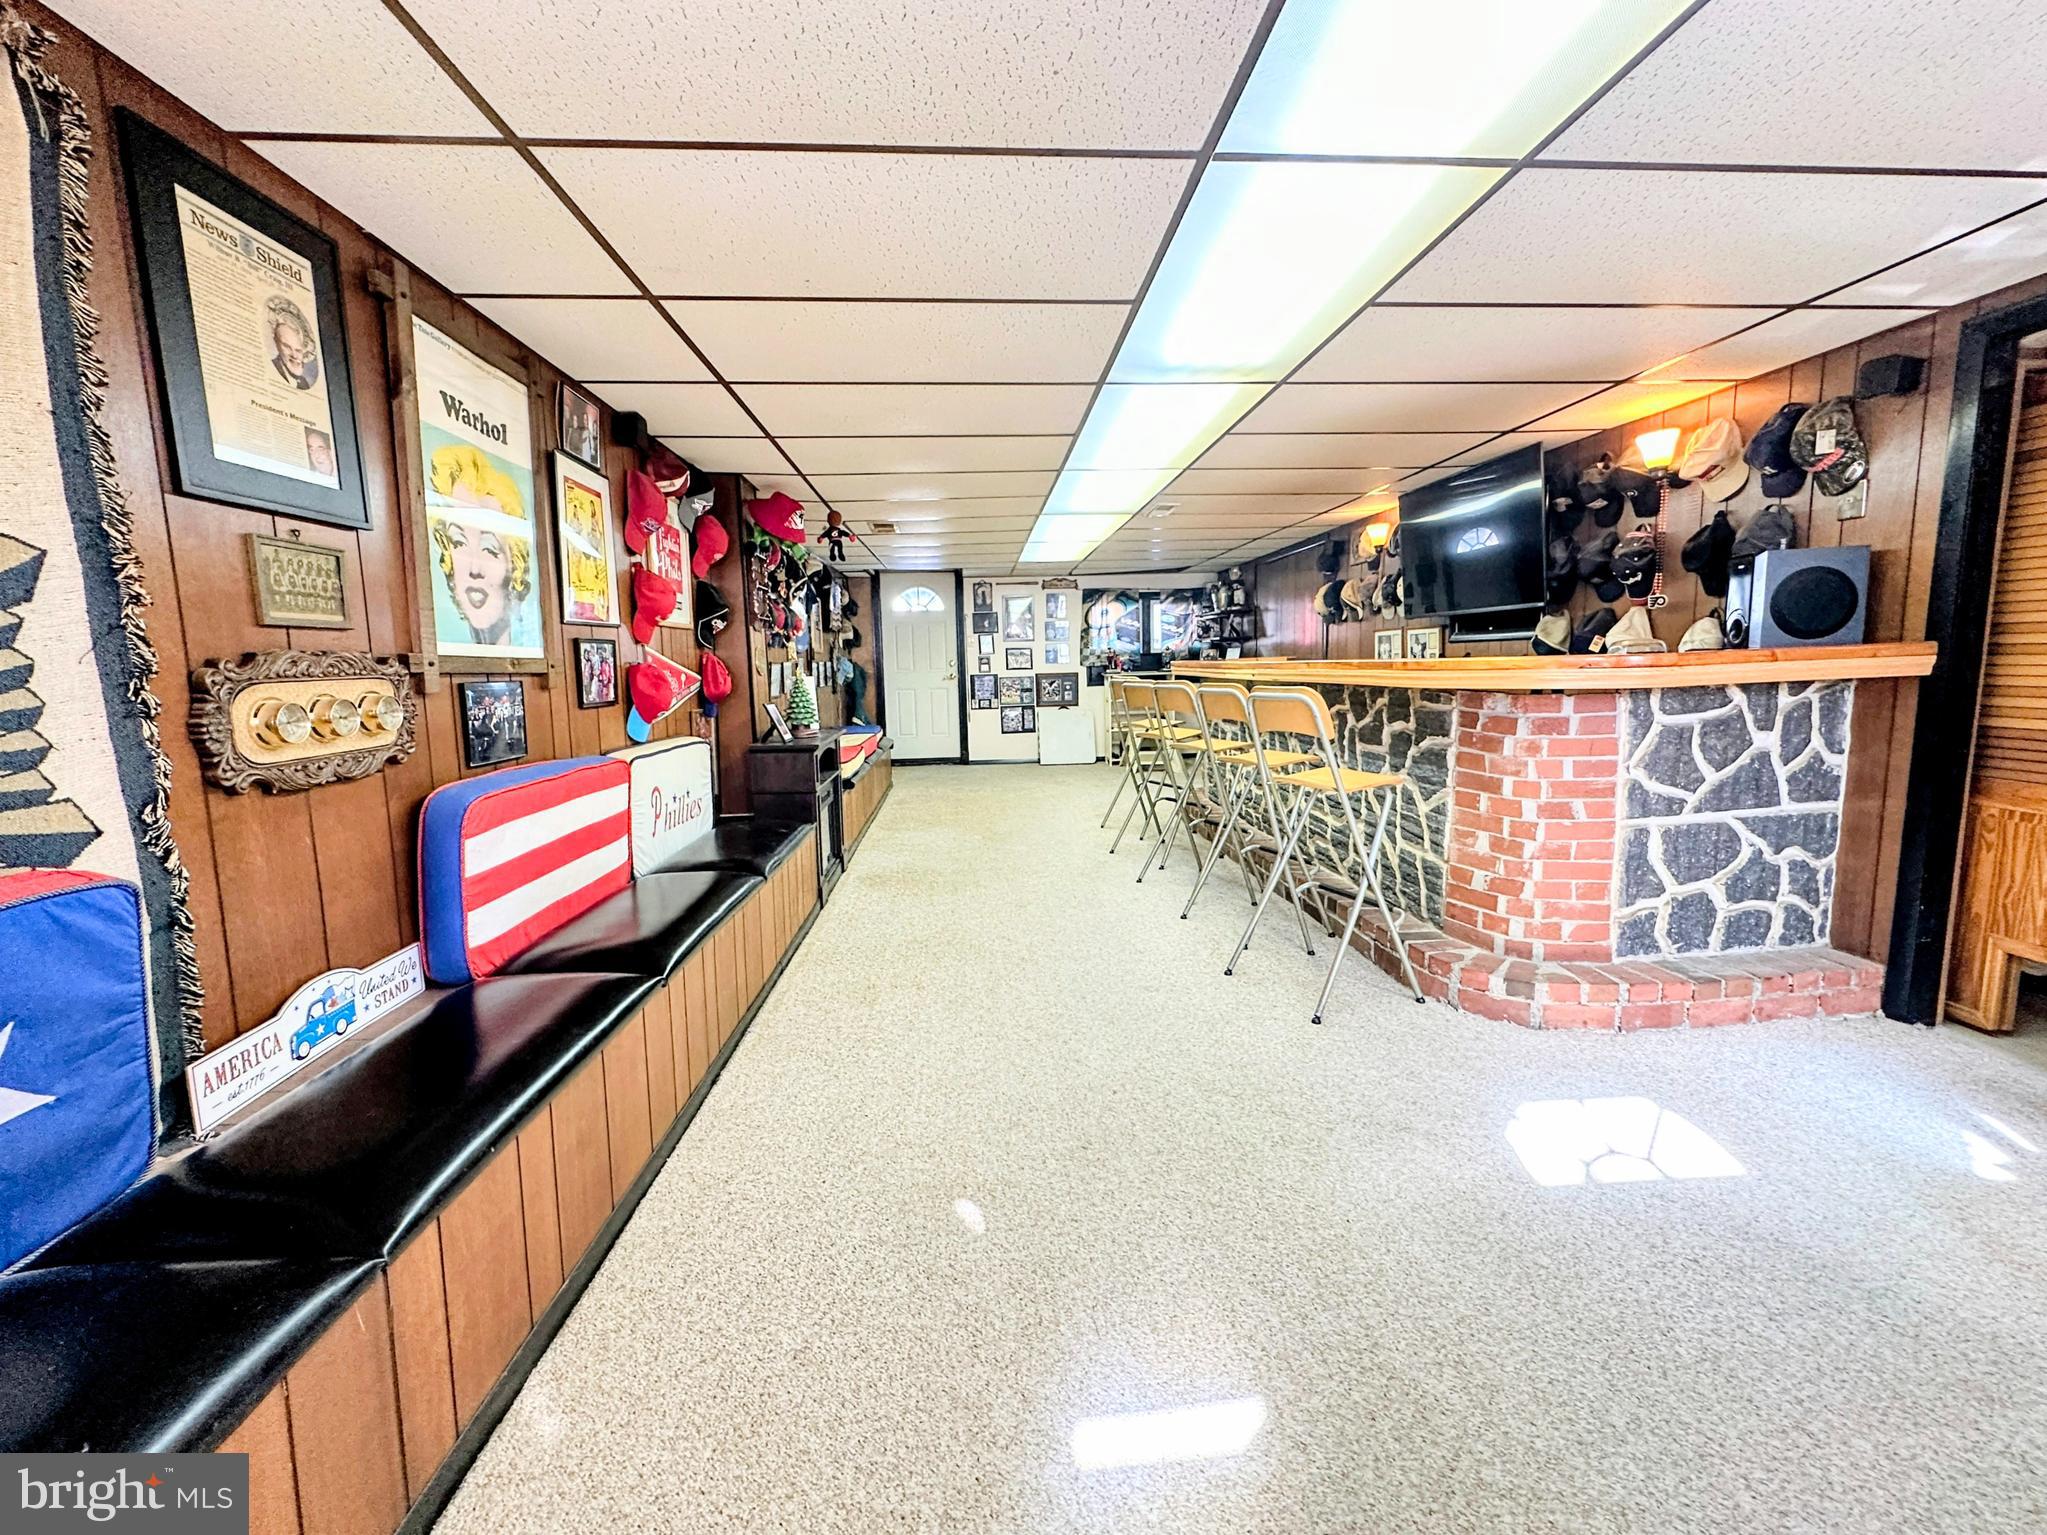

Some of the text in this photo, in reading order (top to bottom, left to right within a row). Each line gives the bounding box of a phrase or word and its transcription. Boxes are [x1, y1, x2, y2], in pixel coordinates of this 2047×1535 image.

[189, 208, 238, 248] News
[255, 246, 303, 283] Shield
[439, 390, 508, 445] Warhol
[651, 786, 702, 838] Phillies
[359, 956, 418, 999] United We
[374, 978, 409, 1008] STAND
[203, 1032, 283, 1098] AMERICA
